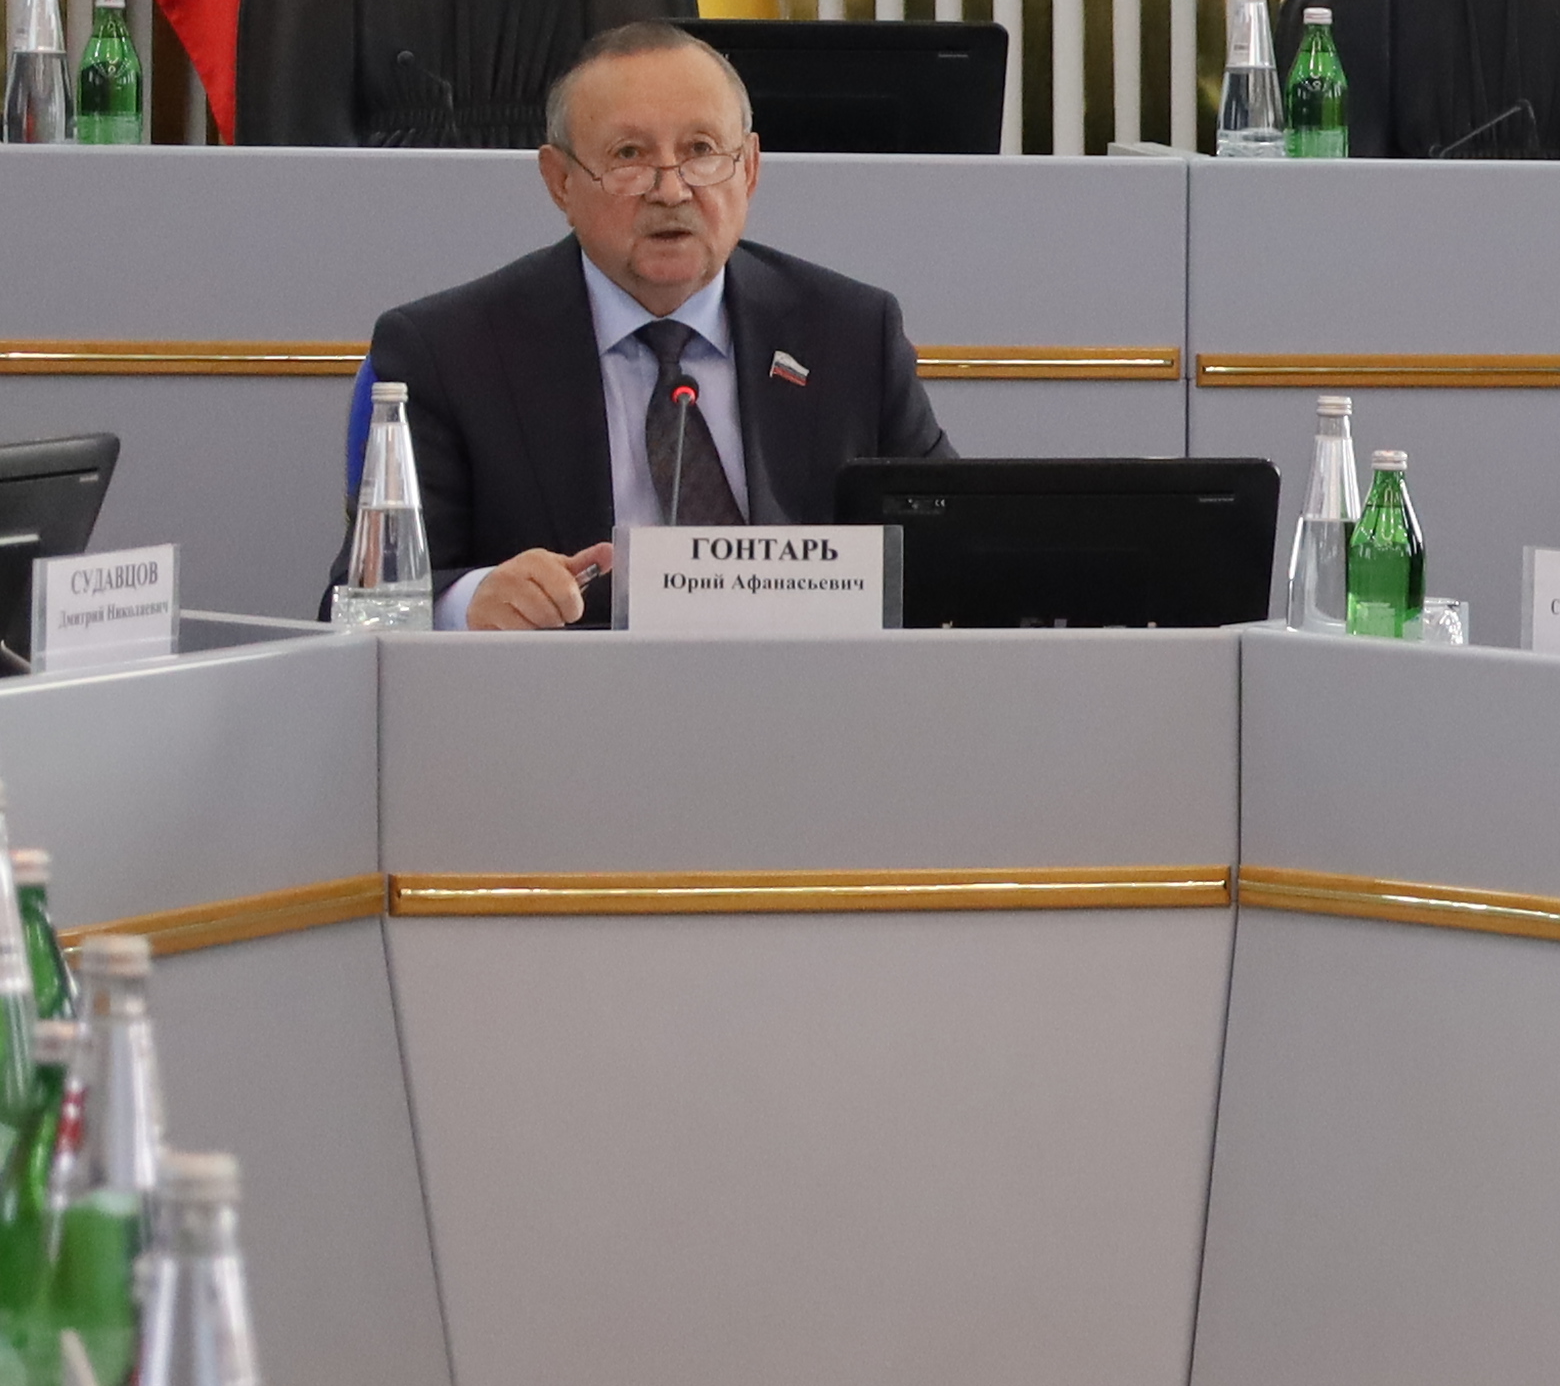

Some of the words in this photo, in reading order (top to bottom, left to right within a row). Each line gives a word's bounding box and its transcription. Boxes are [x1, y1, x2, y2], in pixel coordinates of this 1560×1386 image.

[690, 537, 838, 562] ГОНТАРЬ
[71, 561, 159, 595] СУДАВЦОВ
[663, 572, 725, 594] Юрий
[731, 572, 864, 594] Афанасьевич
[58, 606, 104, 629] Дмитрий
[107, 600, 169, 623] Николаевич
